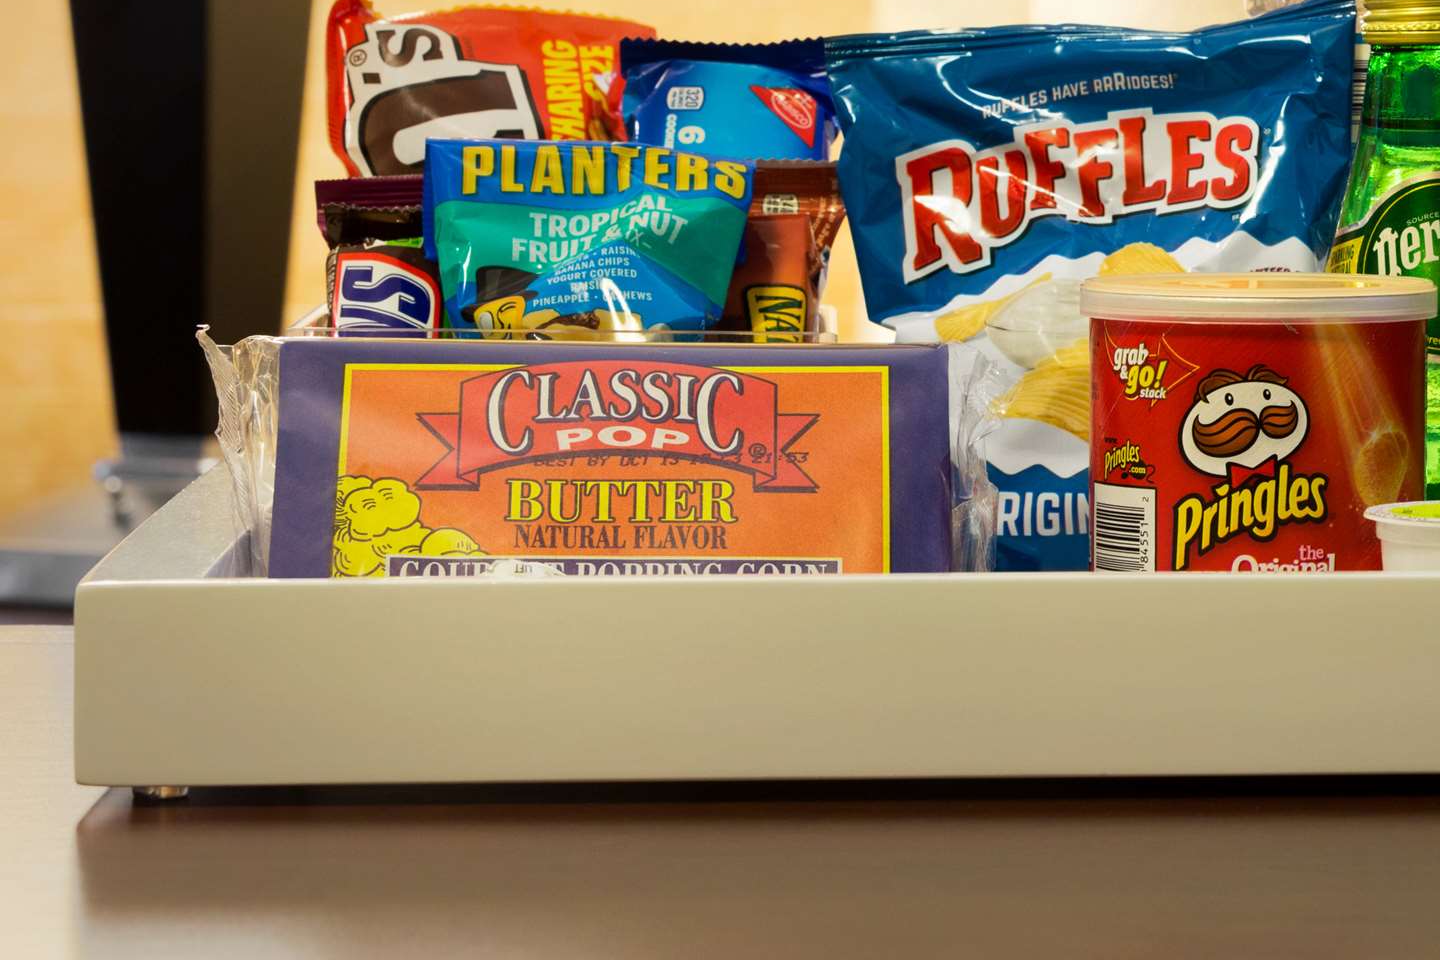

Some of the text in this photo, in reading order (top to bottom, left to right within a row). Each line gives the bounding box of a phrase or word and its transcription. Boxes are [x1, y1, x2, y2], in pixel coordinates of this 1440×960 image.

[541, 38, 587, 141] HARING
[1052, 80, 1089, 102] HAVE
[460, 144, 747, 200] PLANTERS
[906, 114, 1258, 272] RUFFLES
[529, 194, 673, 238] TROPICAL
[1406, 211, 1440, 226] SOURCE
[511, 233, 598, 264] FRUIT
[628, 211, 689, 245] NUT
[589, 267, 638, 280] COVERED
[597, 256, 630, 268] CHIPS
[602, 290, 653, 303] CHEWS
[1113, 342, 1150, 371] grab
[1124, 359, 1168, 395] go!
[1139, 387, 1167, 400] stack
[487, 367, 745, 456] CLASSIC
[556, 425, 690, 451] POP
[1103, 439, 1141, 480] Pringles
[504, 478, 739, 524] BUTTER
[996, 491, 1091, 537] RIGIN
[1174, 462, 1327, 572] Pringles
[513, 523, 729, 550] NATURAL FLAVOR
[1140, 521, 1150, 571] 84551
[1299, 544, 1325, 562] the
